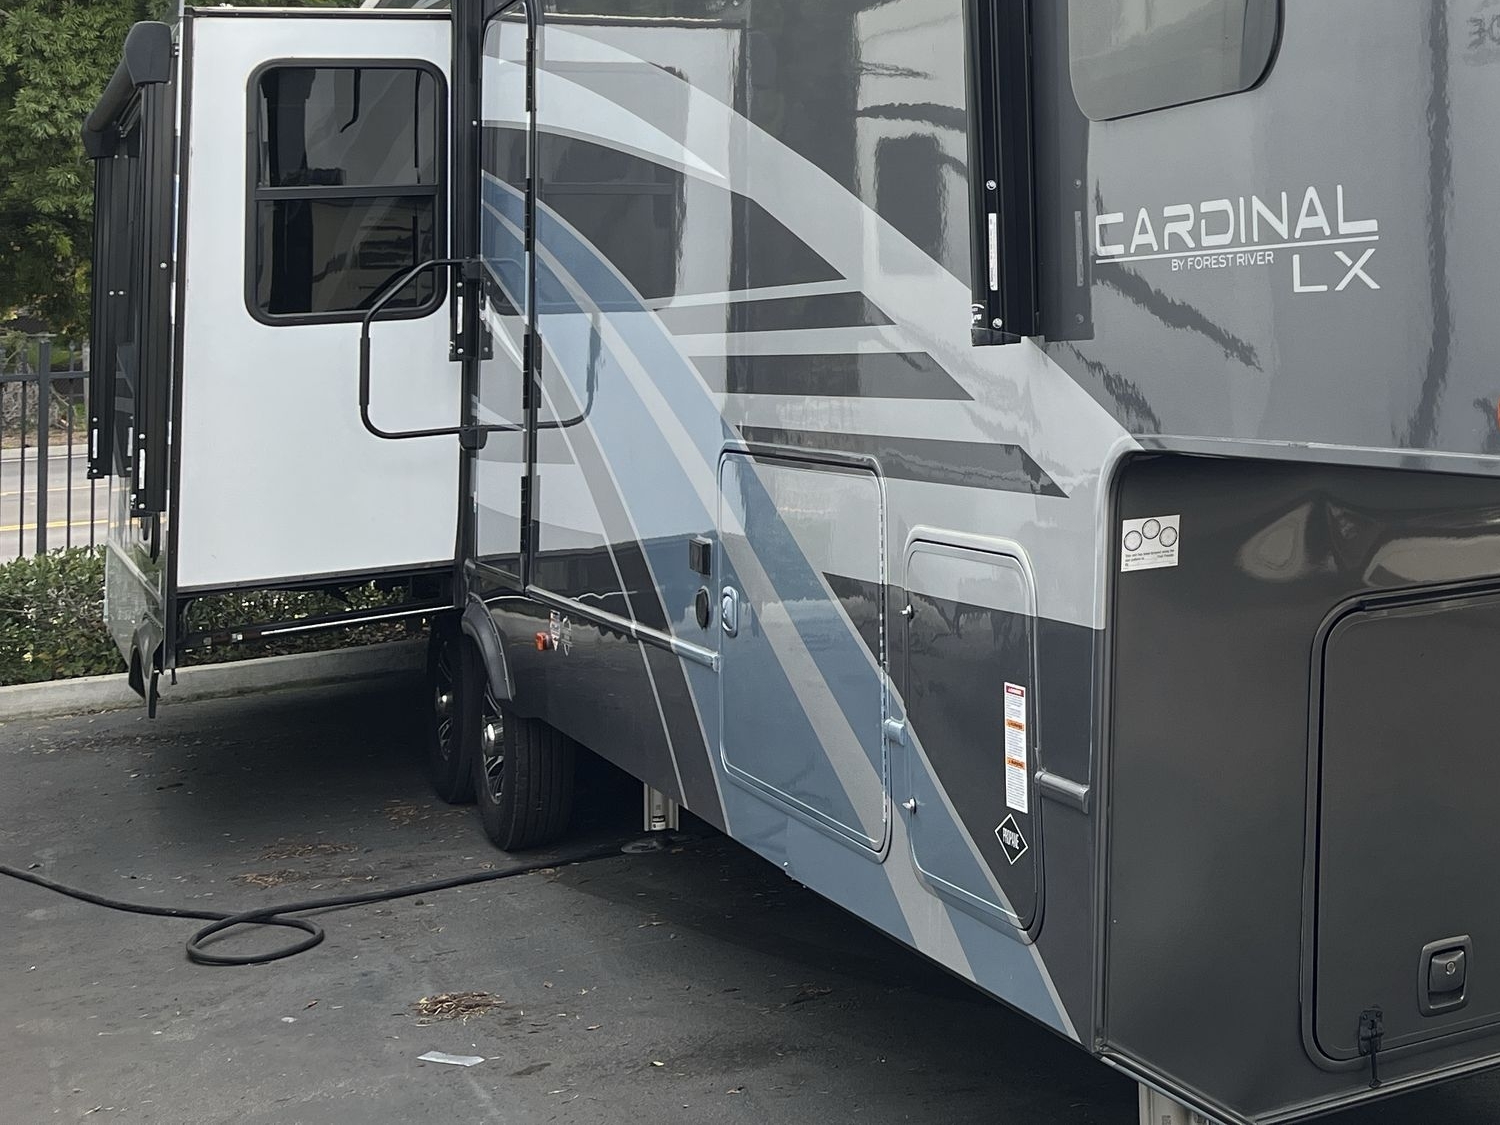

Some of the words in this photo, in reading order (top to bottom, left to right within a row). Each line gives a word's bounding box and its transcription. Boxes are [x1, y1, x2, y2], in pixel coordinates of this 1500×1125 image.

[1095, 184, 1378, 256] CARDINAL
[1171, 259, 1185, 272] BY
[1187, 255, 1232, 270] FOREST
[1236, 251, 1275, 266] RIVER
[1292, 248, 1381, 293] LX
